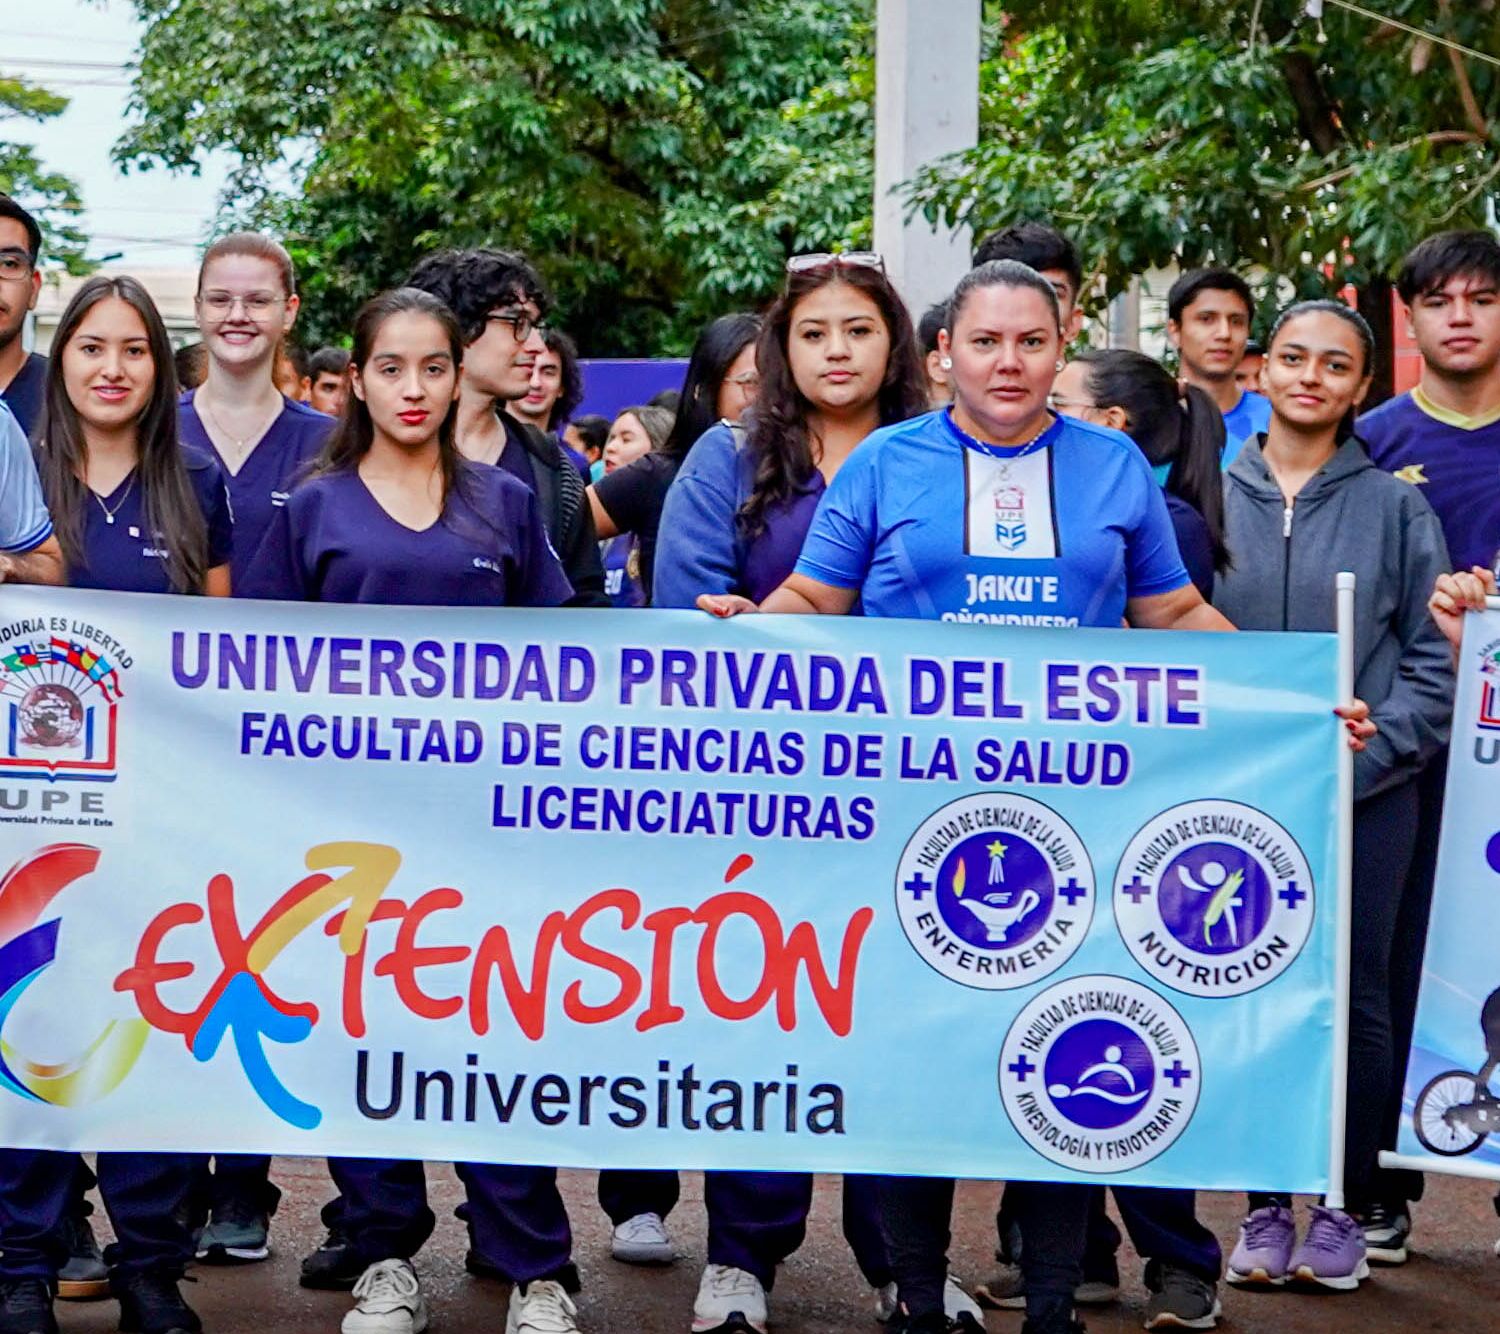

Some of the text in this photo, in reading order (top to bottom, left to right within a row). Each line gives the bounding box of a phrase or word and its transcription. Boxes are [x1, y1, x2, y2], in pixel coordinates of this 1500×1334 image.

[50, 617, 67, 632] ES
[71, 619, 134, 669] LIBERTAD
[171, 631, 1201, 725] UNIVERSIDAD PRIVADA DEL ESTE
[240, 712, 1131, 786] FACULTAD DE CIENCIAS DE LA SALUD
[41, 816, 74, 825] Privada
[77, 818, 91, 826] del
[94, 818, 114, 827] Este
[491, 784, 876, 841] LICENCIATURAS
[917, 807, 1076, 873] FACULTAD DE CIENCIAS DE LA SALUD
[1135, 815, 1296, 880] FACULTAD DE CIENCIAS DE LA SALUD
[916, 912, 1075, 975] ENFERMERÍA
[1138, 931, 1290, 986] NUTRICIÓN
[1020, 990, 1180, 1057] FACULTAD DE CIENCIAS DE LA SALUD
[355, 1050, 847, 1135] Universitaria
[1016, 1091, 1182, 1160] KINESIOLOGÍA Y FISIOTERAPIA
